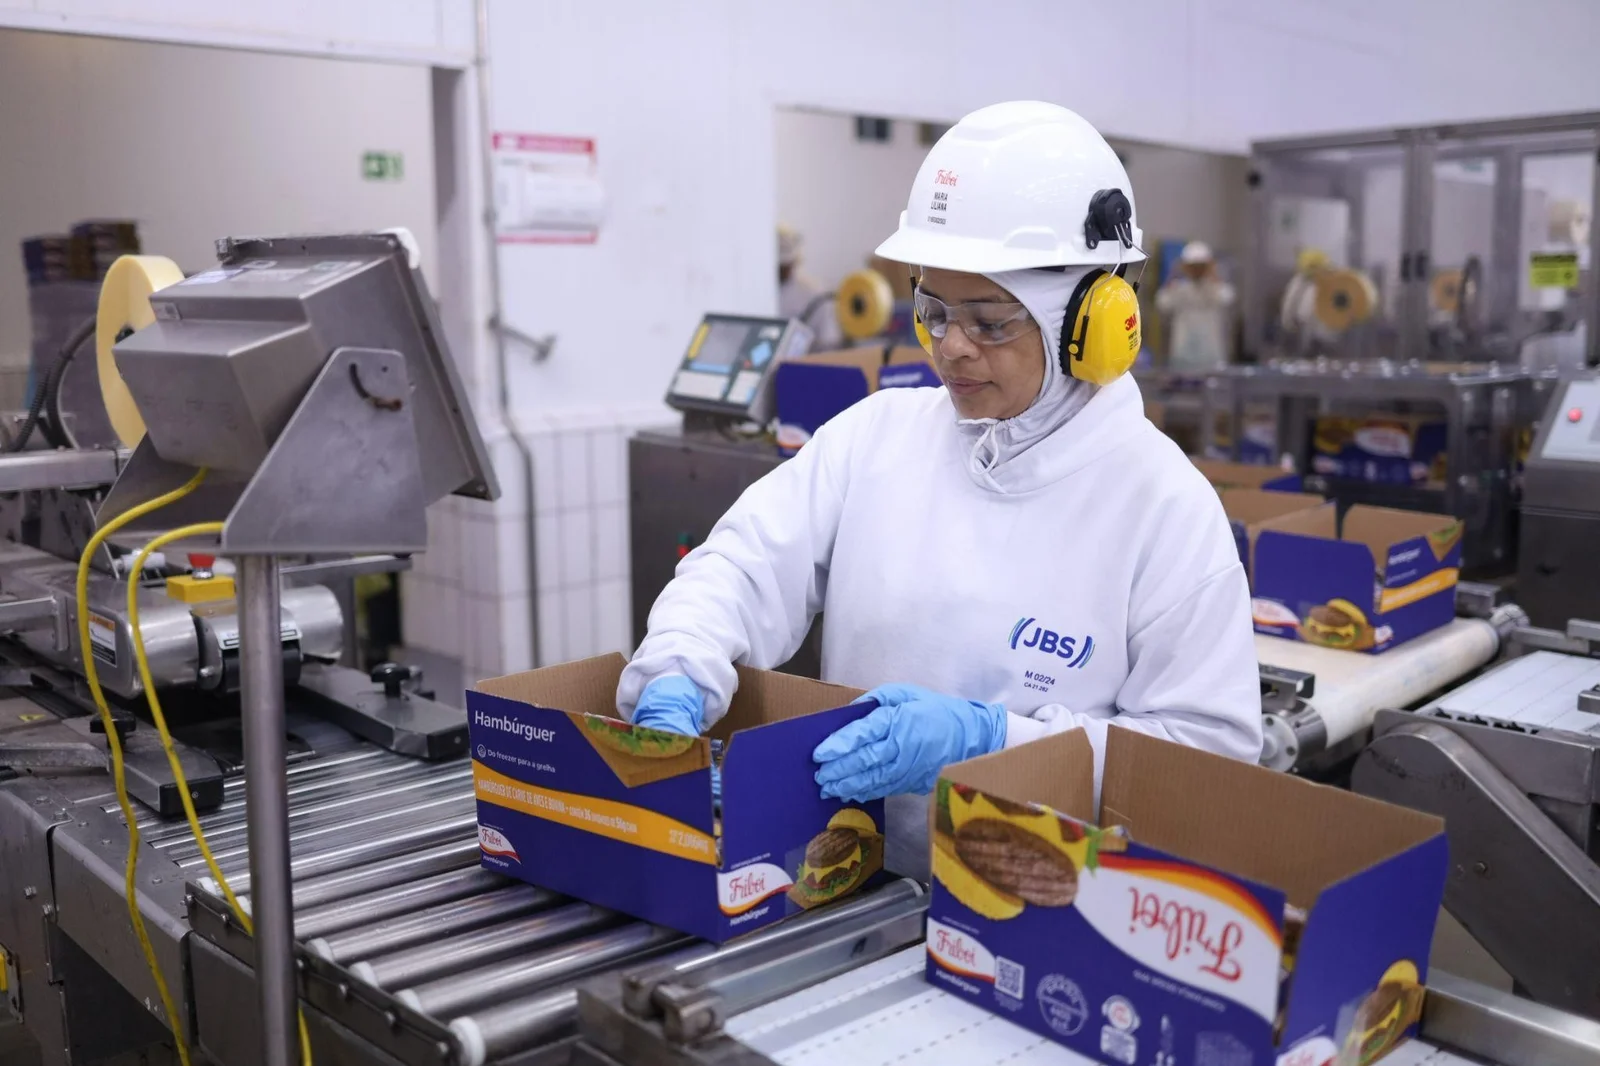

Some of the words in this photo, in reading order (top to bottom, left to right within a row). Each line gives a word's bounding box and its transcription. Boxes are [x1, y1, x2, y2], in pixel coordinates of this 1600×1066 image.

[934, 191, 949, 201] MARIA
[1124, 313, 1137, 331] 3M
[1025, 670, 1033, 679] M
[1034, 673, 1055, 685] 02/24
[474, 710, 556, 742] Hambúrguer
[487, 749, 496, 758] Do
[496, 750, 517, 763] freezer
[517, 758, 531, 768] para
[536, 762, 556, 773] grelha
[1128, 886, 1244, 984] Friboi
